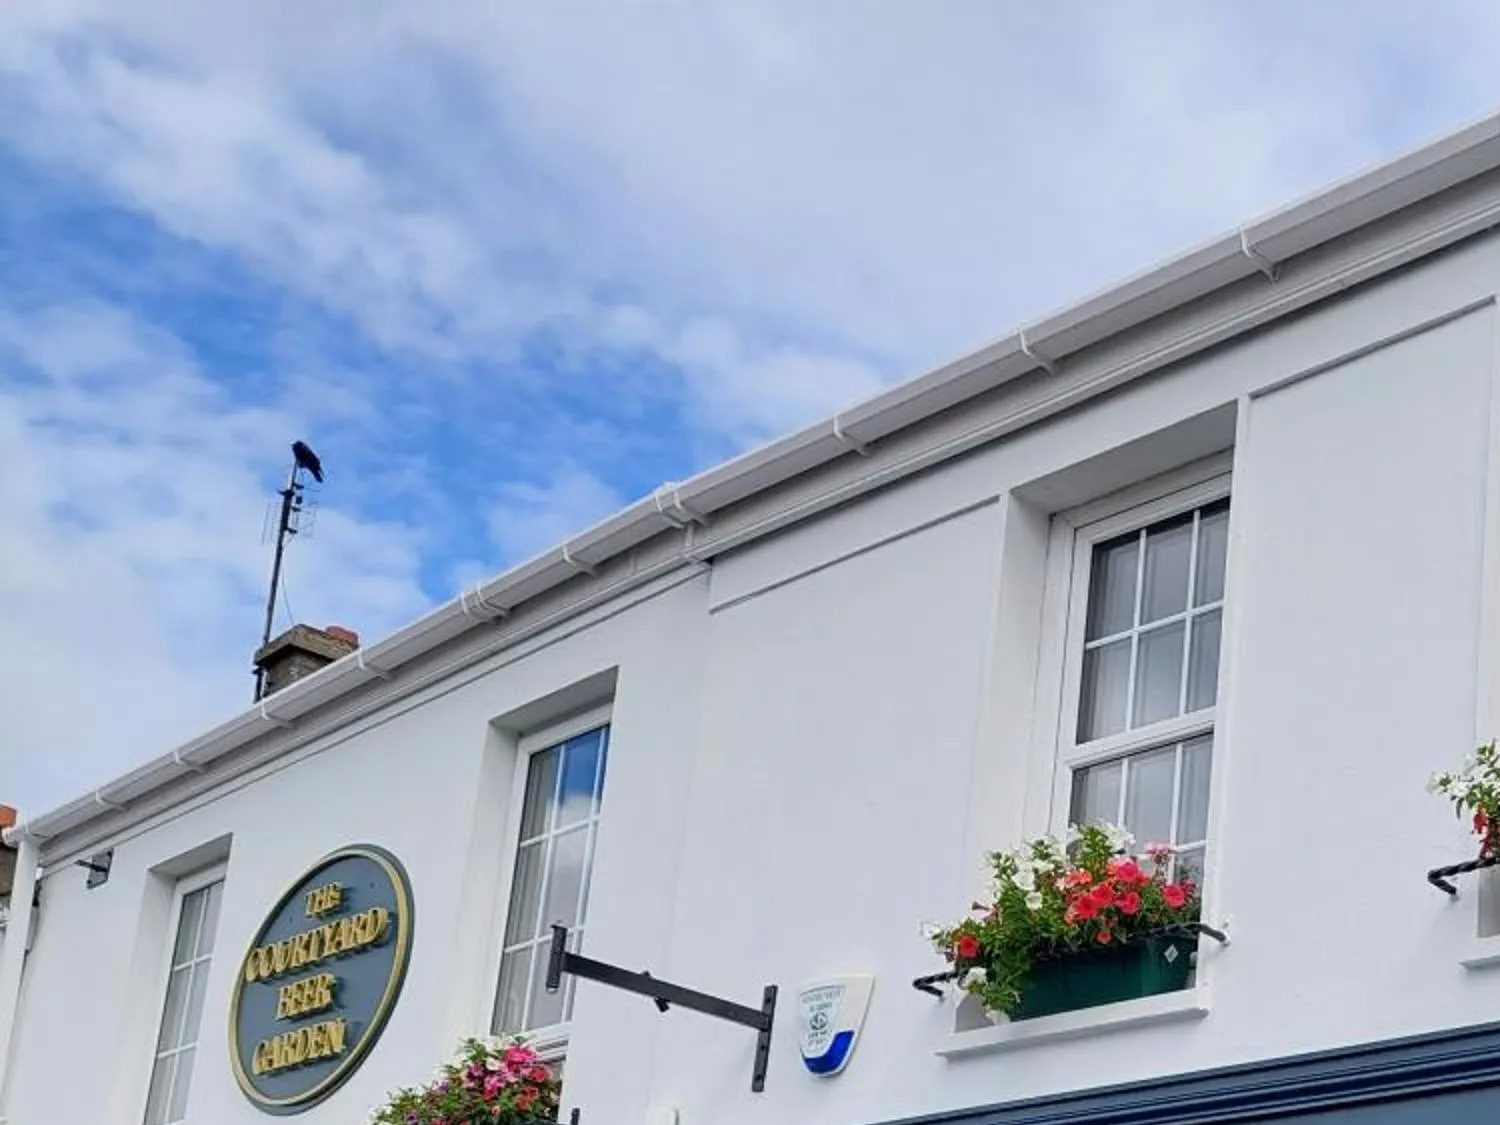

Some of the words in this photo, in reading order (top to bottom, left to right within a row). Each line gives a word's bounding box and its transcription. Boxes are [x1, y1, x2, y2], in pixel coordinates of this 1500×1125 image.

[245, 907, 389, 981] COURTYARD
[276, 972, 337, 1021] BEER
[252, 1018, 347, 1075] GARDEN
